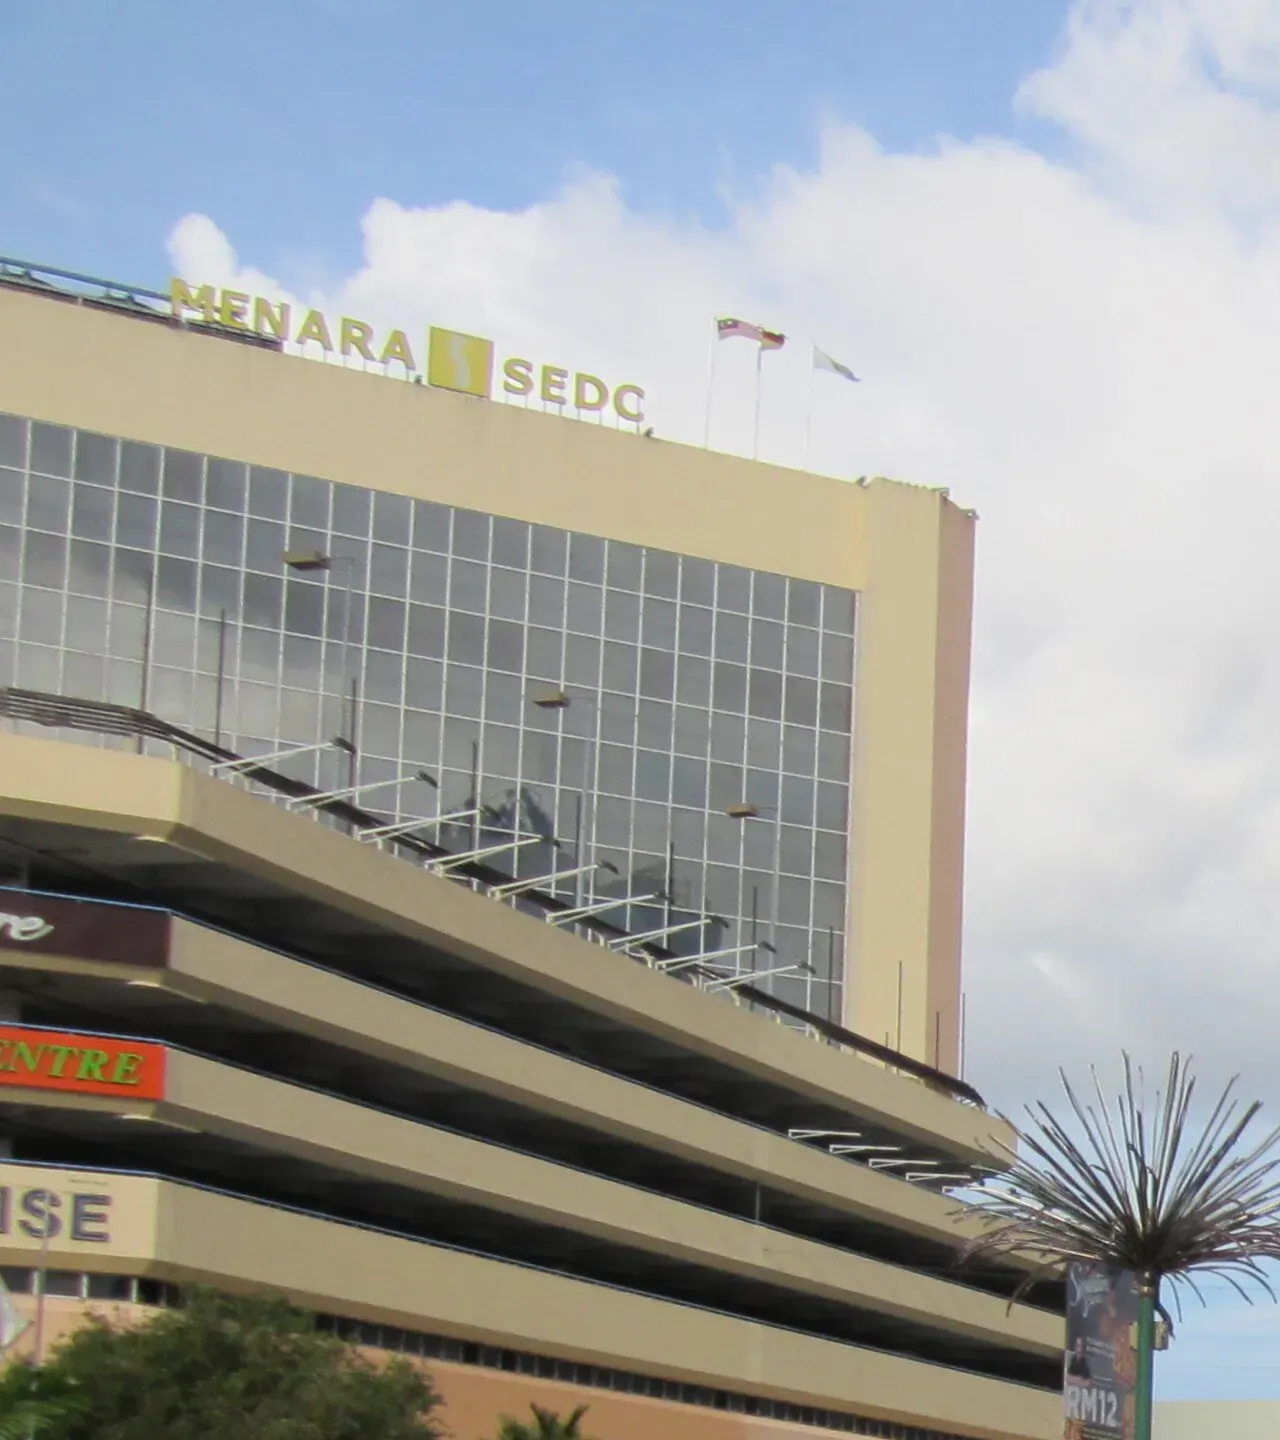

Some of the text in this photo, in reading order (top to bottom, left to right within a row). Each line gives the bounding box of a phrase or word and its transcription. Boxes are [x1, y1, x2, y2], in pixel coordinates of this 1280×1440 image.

[170, 277, 416, 370] MENARA
[502, 356, 646, 422] SEDC
[1064, 1385, 1118, 1428] RM12
